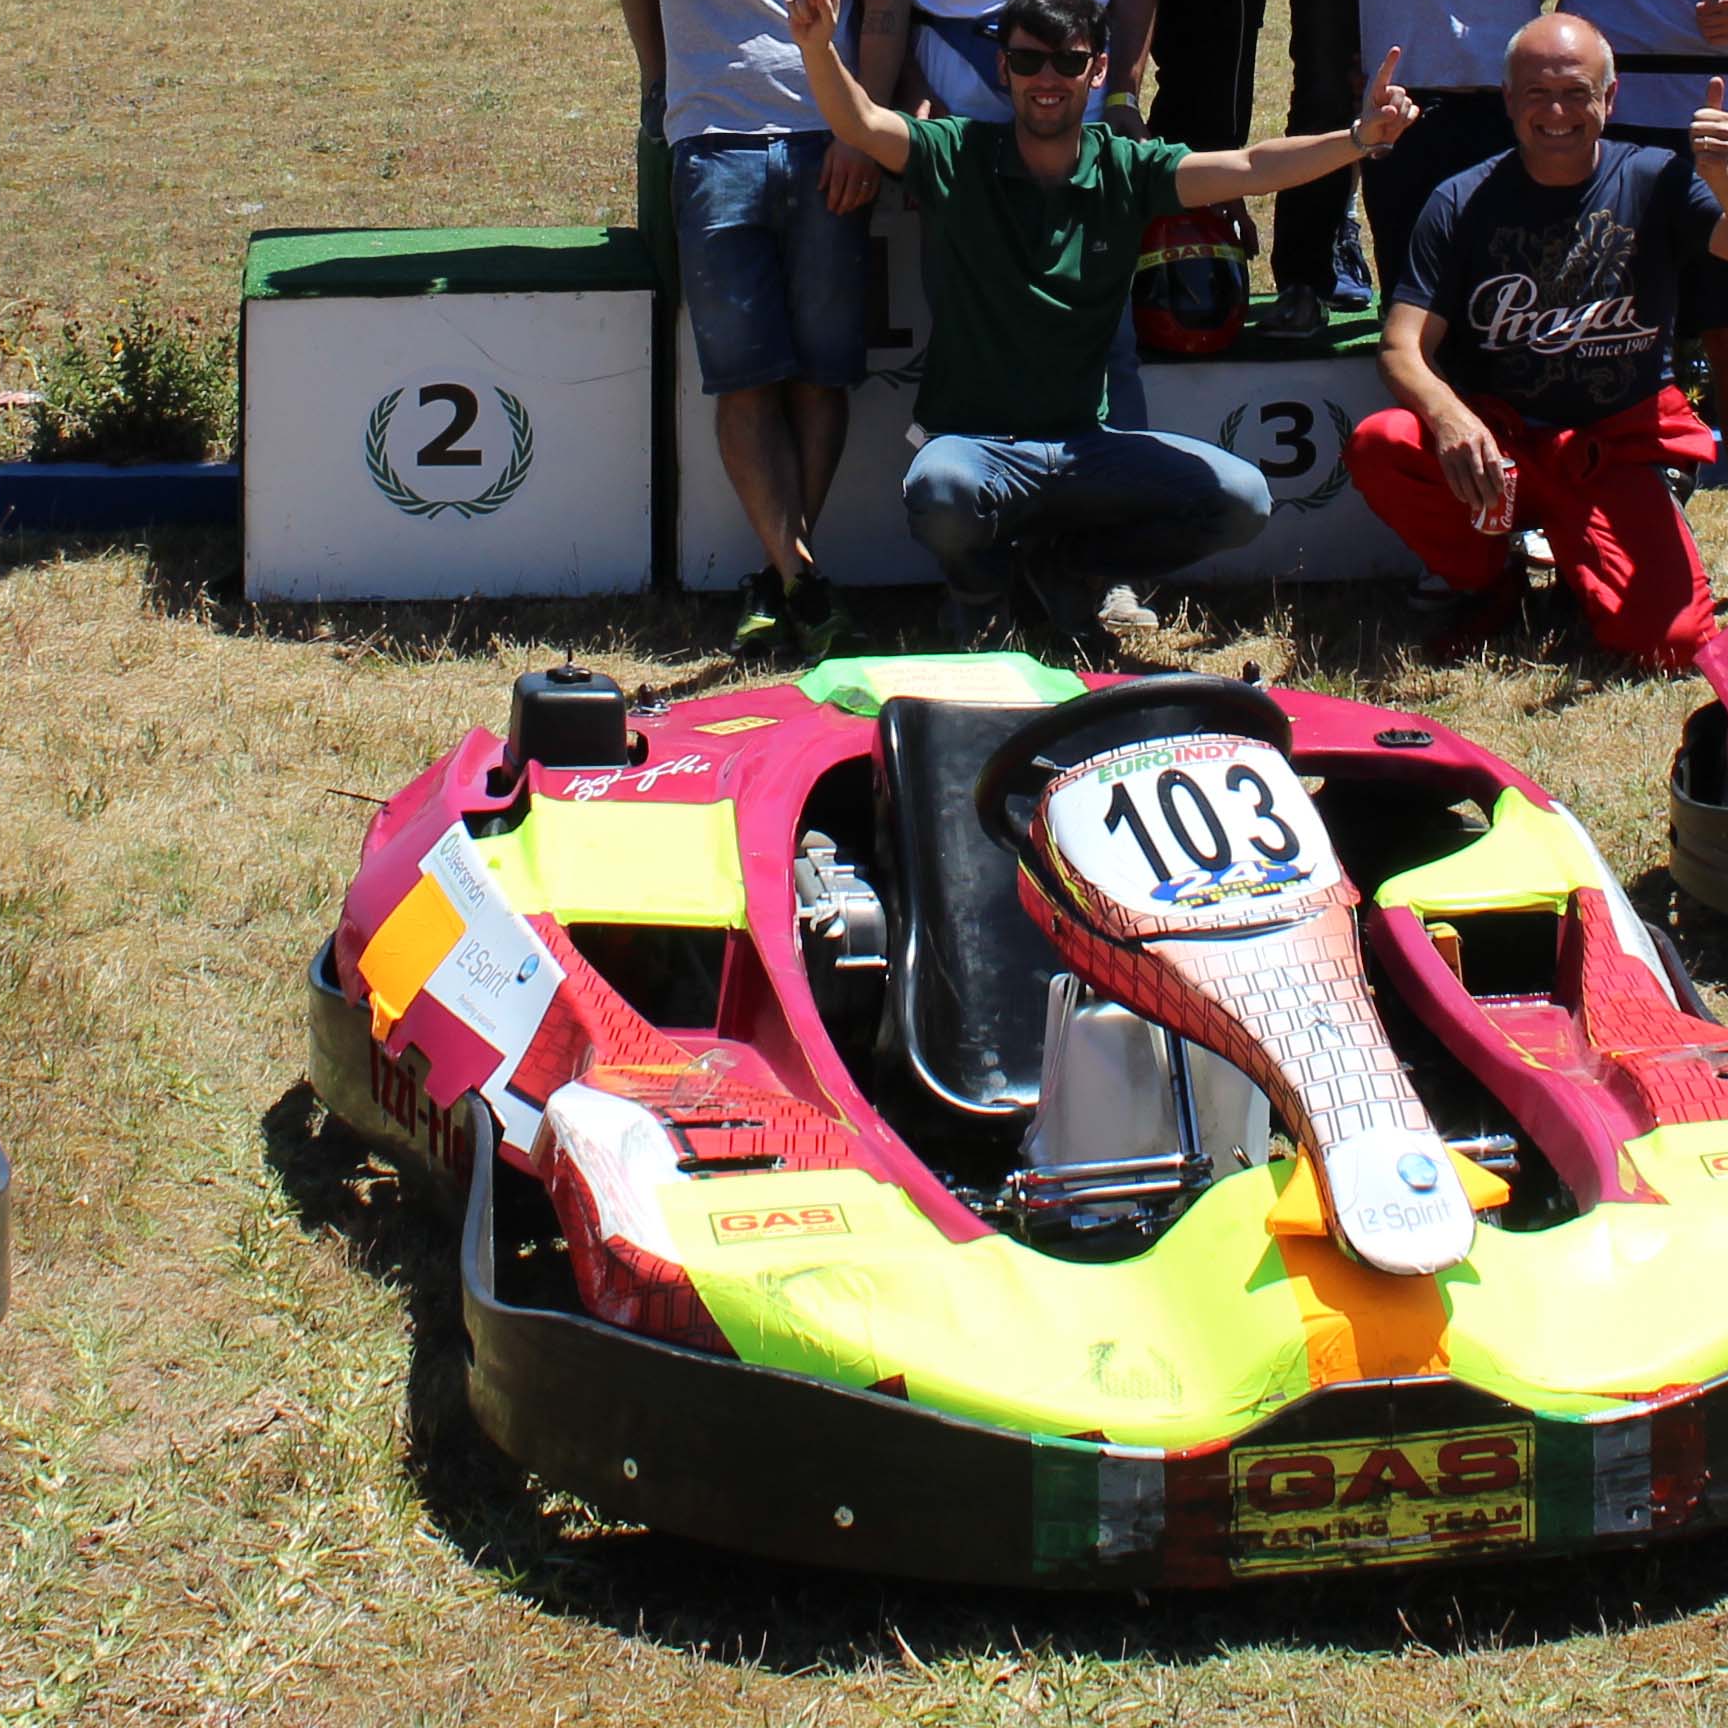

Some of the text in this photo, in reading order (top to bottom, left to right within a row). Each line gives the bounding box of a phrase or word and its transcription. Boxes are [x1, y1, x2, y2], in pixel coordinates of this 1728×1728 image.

[1576, 335, 1655, 359] Since 1907
[416, 383, 482, 466] 2
[1258, 401, 1315, 478] 3
[1097, 743, 1240, 784] EUROINDY
[1103, 763, 1301, 883] 103
[445, 842, 487, 909] Steersman
[475, 952, 511, 999] Spirit
[721, 1208, 835, 1232] GAS
[1383, 1200, 1452, 1234] Spirit
[1245, 1436, 1521, 1512] GAS
[1423, 1504, 1524, 1534] TEAM
